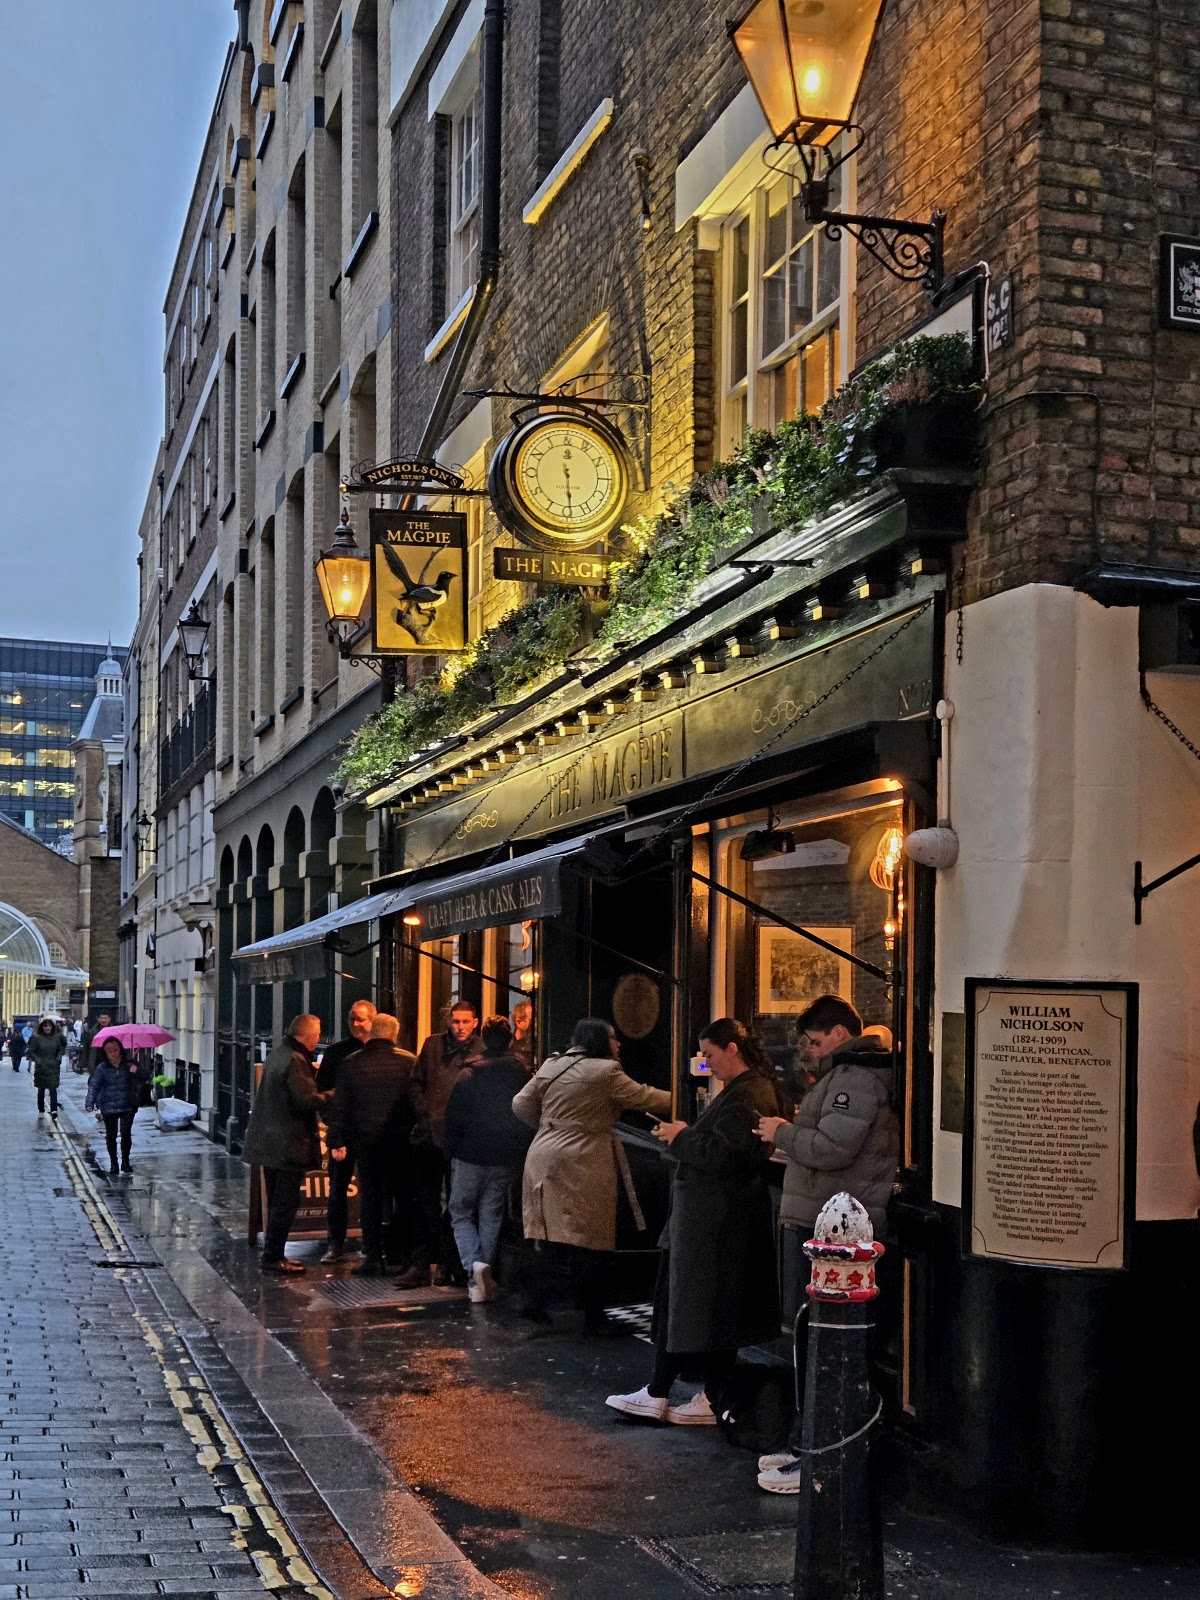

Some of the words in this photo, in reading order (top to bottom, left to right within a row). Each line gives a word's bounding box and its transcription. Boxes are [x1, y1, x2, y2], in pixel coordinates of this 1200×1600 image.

[367, 464, 458, 487] NICHOLSON'S
[407, 521, 430, 530] THE
[387, 530, 451, 544] MAGPIE
[503, 556, 541, 574] THE
[550, 560, 607, 578] MAGPI
[547, 763, 582, 819] THE
[591, 727, 672, 804] MAGPIE
[428, 899, 453, 929] CRAFT
[454, 894, 478, 923] BEER
[479, 891, 488, 918] &
[488, 883, 517, 916] CASK
[519, 876, 542, 909] ALES
[1009, 1006, 1071, 1018] WILLIAM
[1000, 1019, 1084, 1032] NICHOLSON
[1012, 1035, 1067, 1046] (1824-1909)
[992, 1044, 1036, 1054] DISTILLER,
[1039, 1047, 1093, 1056] POLITICAN,
[981, 1053, 1008, 1062] CRICKET
[1010, 1054, 1045, 1064] PLAYER,
[1048, 1057, 1112, 1067] BENEFACTOR
[1013, 1070, 1038, 1078] alehouse
[1047, 1072, 1060, 1080] part
[1027, 1080, 1052, 1088] heritage
[1057, 1089, 1071, 1097] they
[996, 1102, 1021, 1110] Nicholson
[1041, 1105, 1071, 1113] Victorian
[1059, 1132, 1088, 1140] financed
[1068, 1150, 1100, 1158] collection
[1039, 1166, 1062, 1174] delight
[1024, 1173, 1040, 1181] place
[1022, 1207, 1050, 1216] influence
